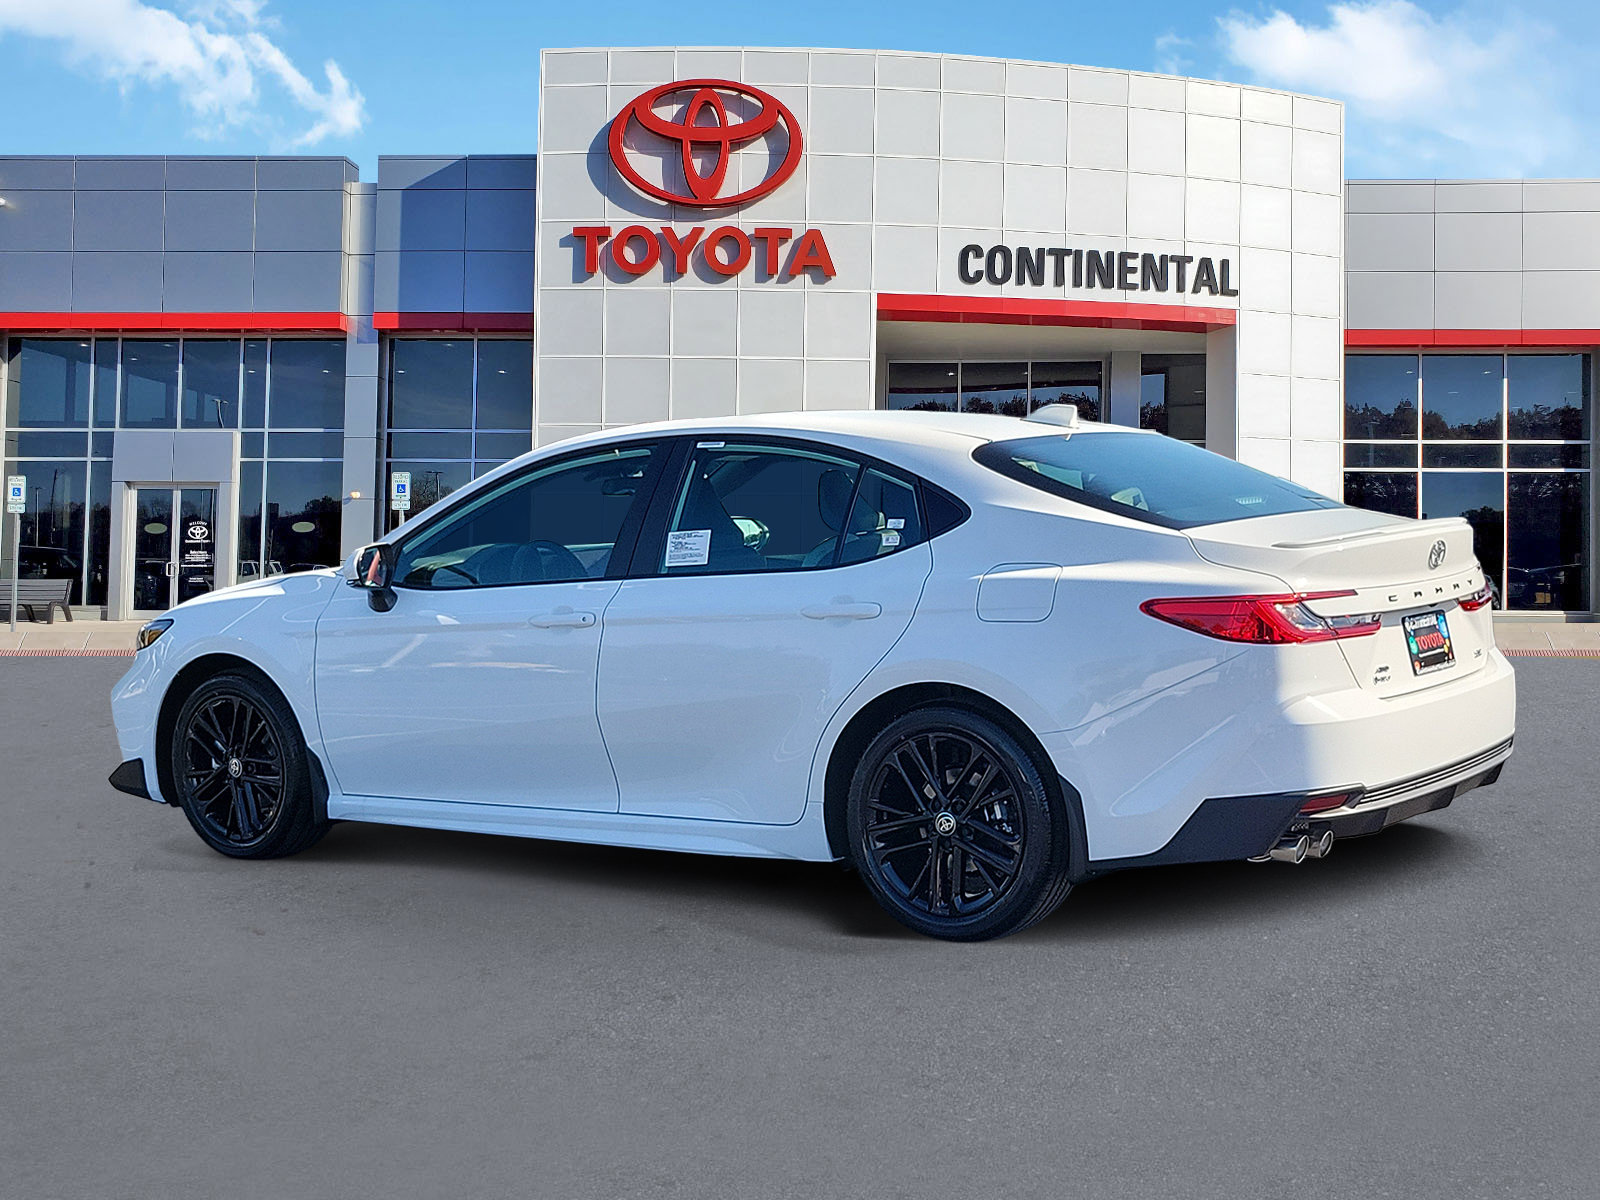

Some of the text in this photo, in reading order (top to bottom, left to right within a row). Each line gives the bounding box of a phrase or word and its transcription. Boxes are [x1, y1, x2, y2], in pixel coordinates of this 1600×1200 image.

[572, 225, 837, 277] TOYOTA
[958, 244, 1239, 296] CONTINENTAL
[1388, 580, 1473, 602] CAMRY
[1415, 632, 1445, 650] TOYOTA
